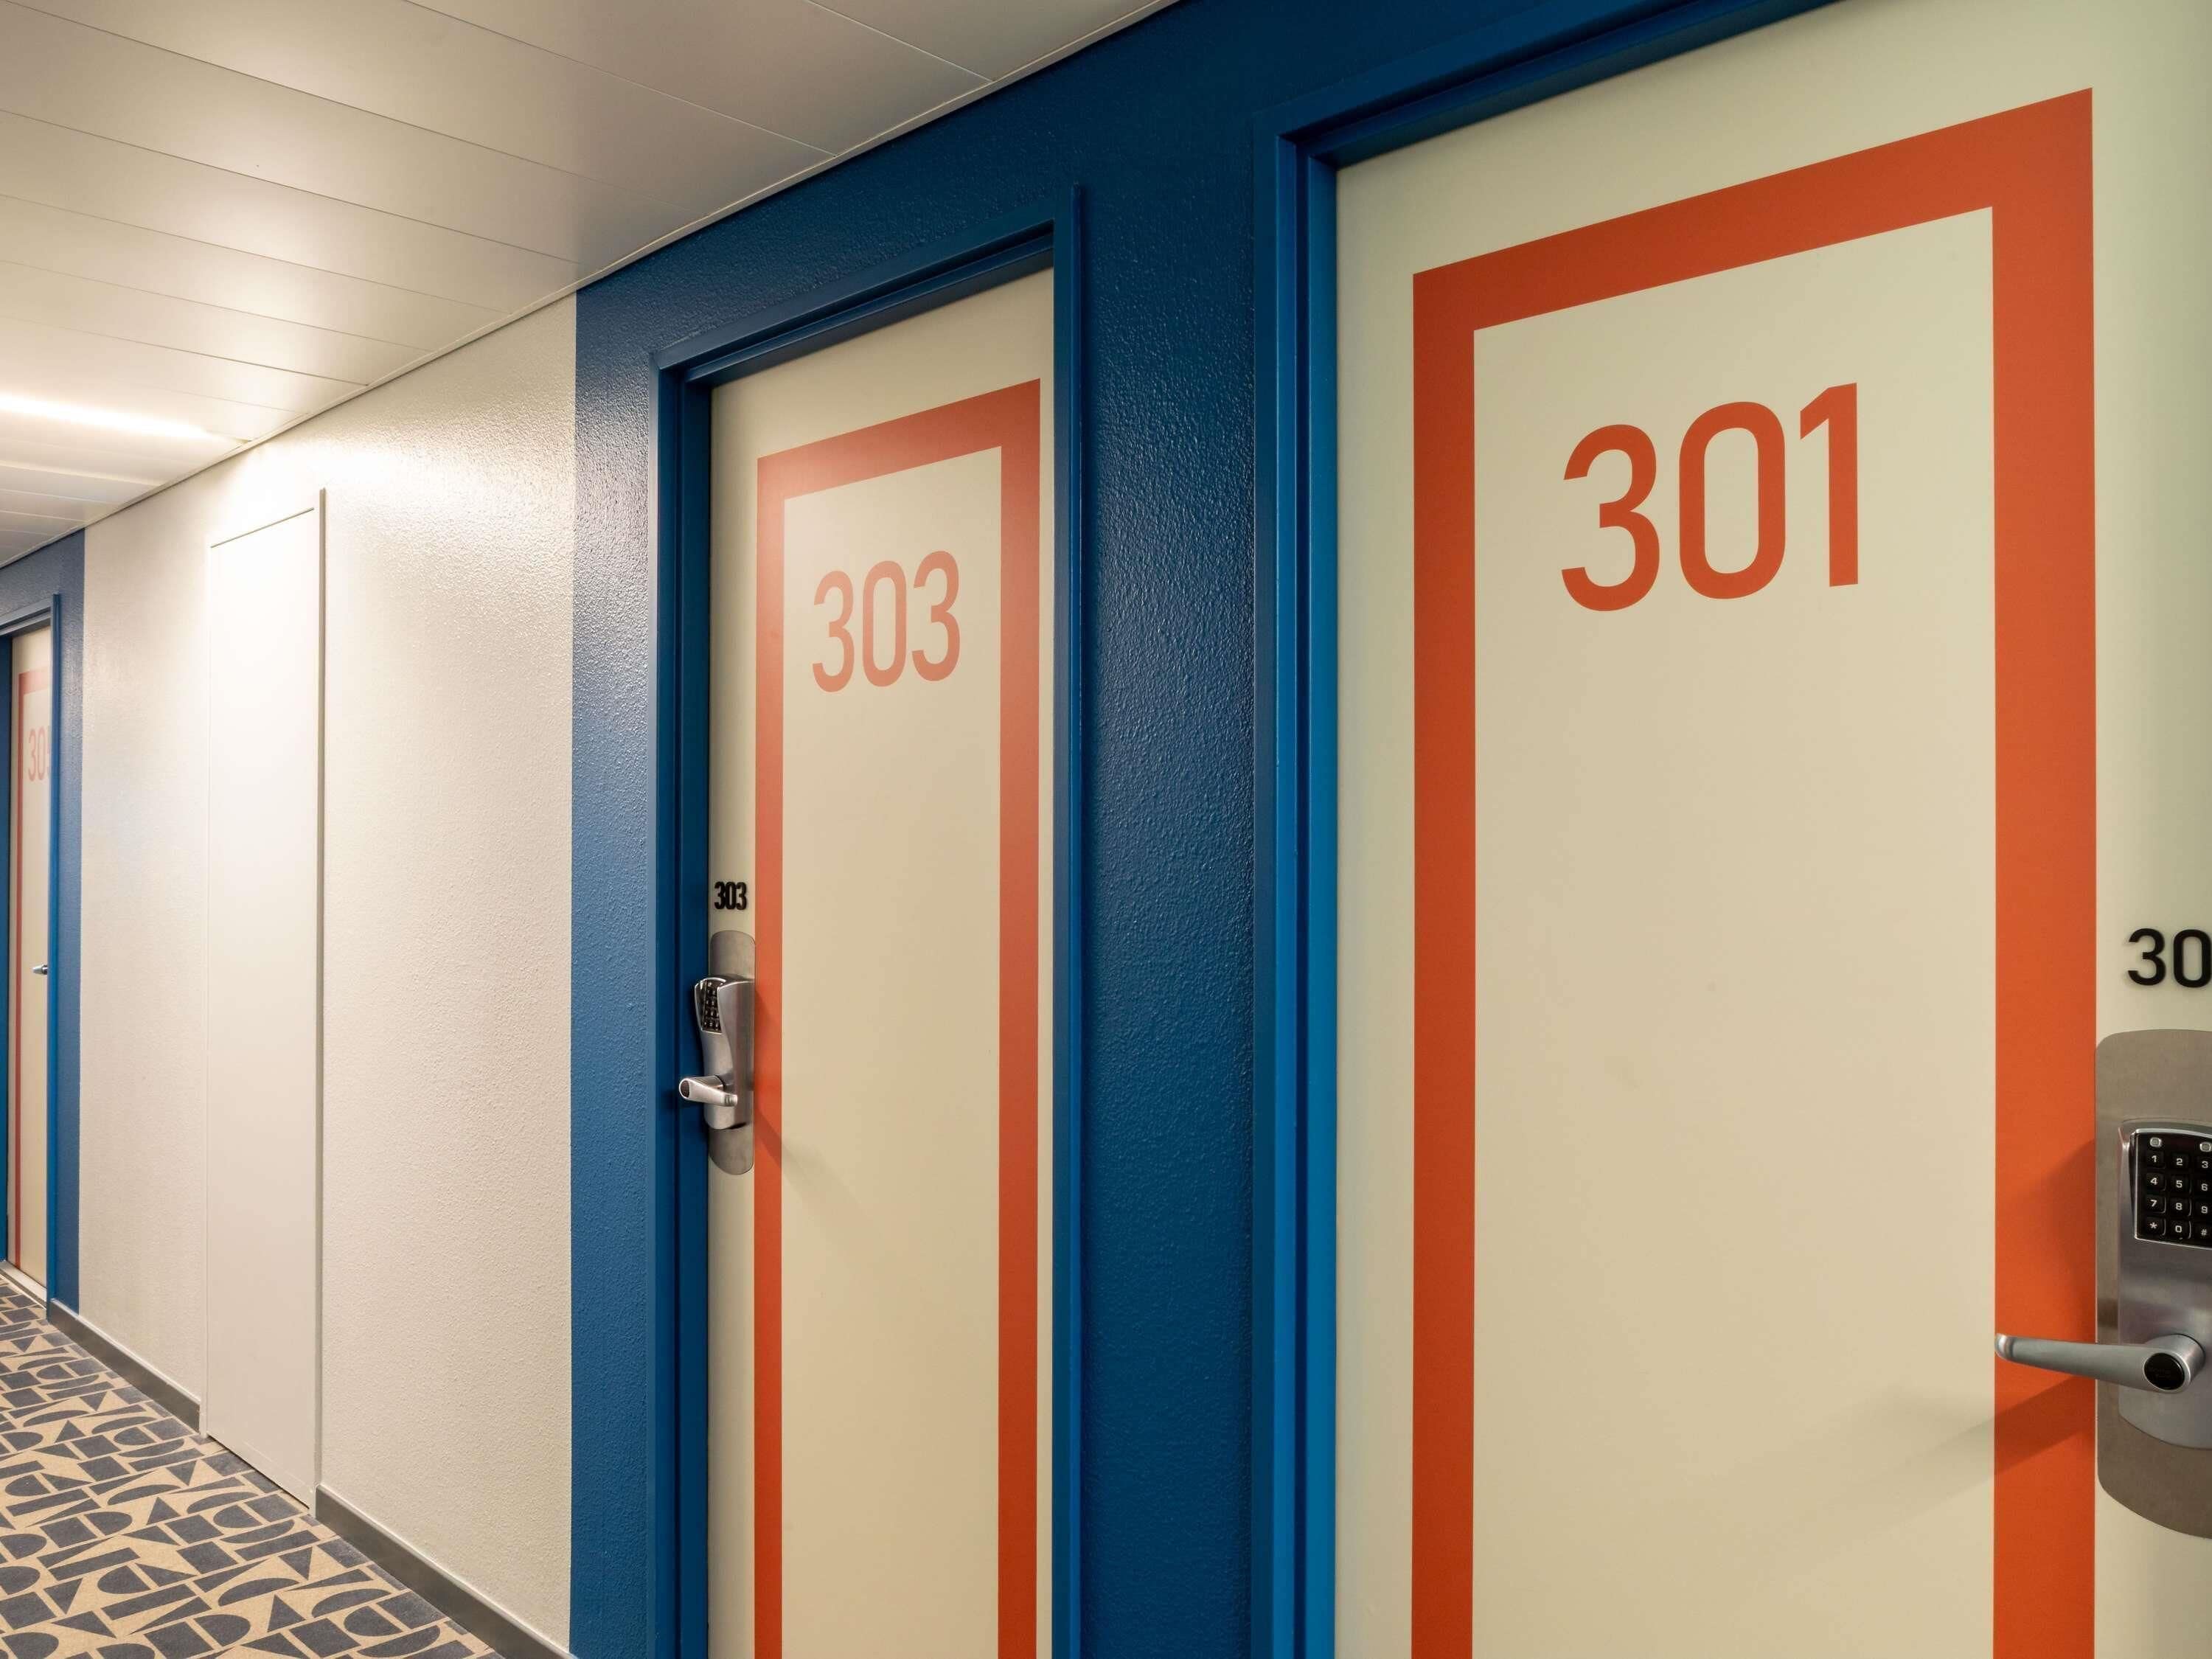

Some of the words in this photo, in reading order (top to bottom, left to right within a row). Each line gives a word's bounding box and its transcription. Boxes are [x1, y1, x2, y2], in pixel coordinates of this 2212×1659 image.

[1561, 382, 1859, 612] 301
[812, 550, 961, 693] 303
[714, 881, 748, 911] 303
[2151, 1155, 2157, 1163] 1
[2176, 1158, 2183, 1166] 2
[2202, 1161, 2209, 1169] 3
[2150, 1177, 2157, 1185] 4
[2176, 1180, 2183, 1188] 5
[2201, 1183, 2208, 1191] 6
[2150, 1199, 2157, 1207] 7
[2175, 1203, 2183, 1211] 8
[2201, 1206, 2208, 1214] 9
[2175, 1225, 2183, 1233] 0
